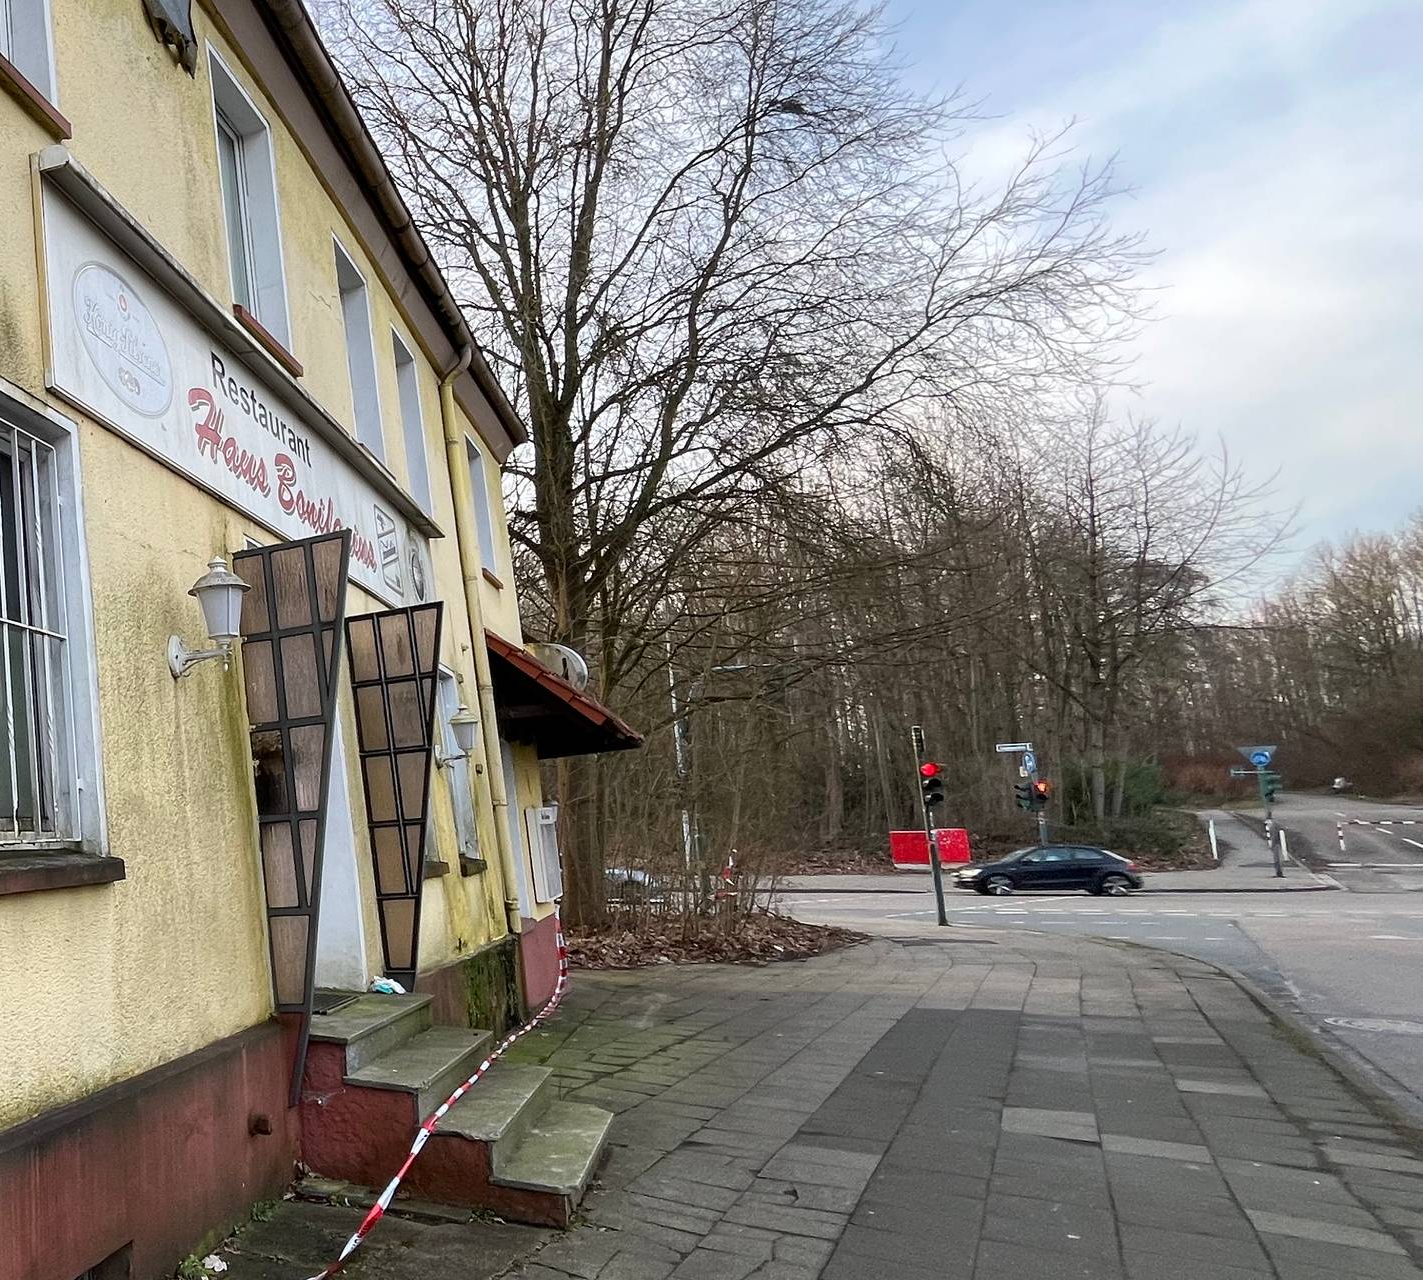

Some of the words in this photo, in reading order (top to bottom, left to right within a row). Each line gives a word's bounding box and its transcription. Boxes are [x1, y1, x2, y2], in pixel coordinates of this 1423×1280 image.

[188, 387, 271, 498] Haus
[275, 452, 377, 573] Bonifius
[211, 351, 312, 468] Restaurant
